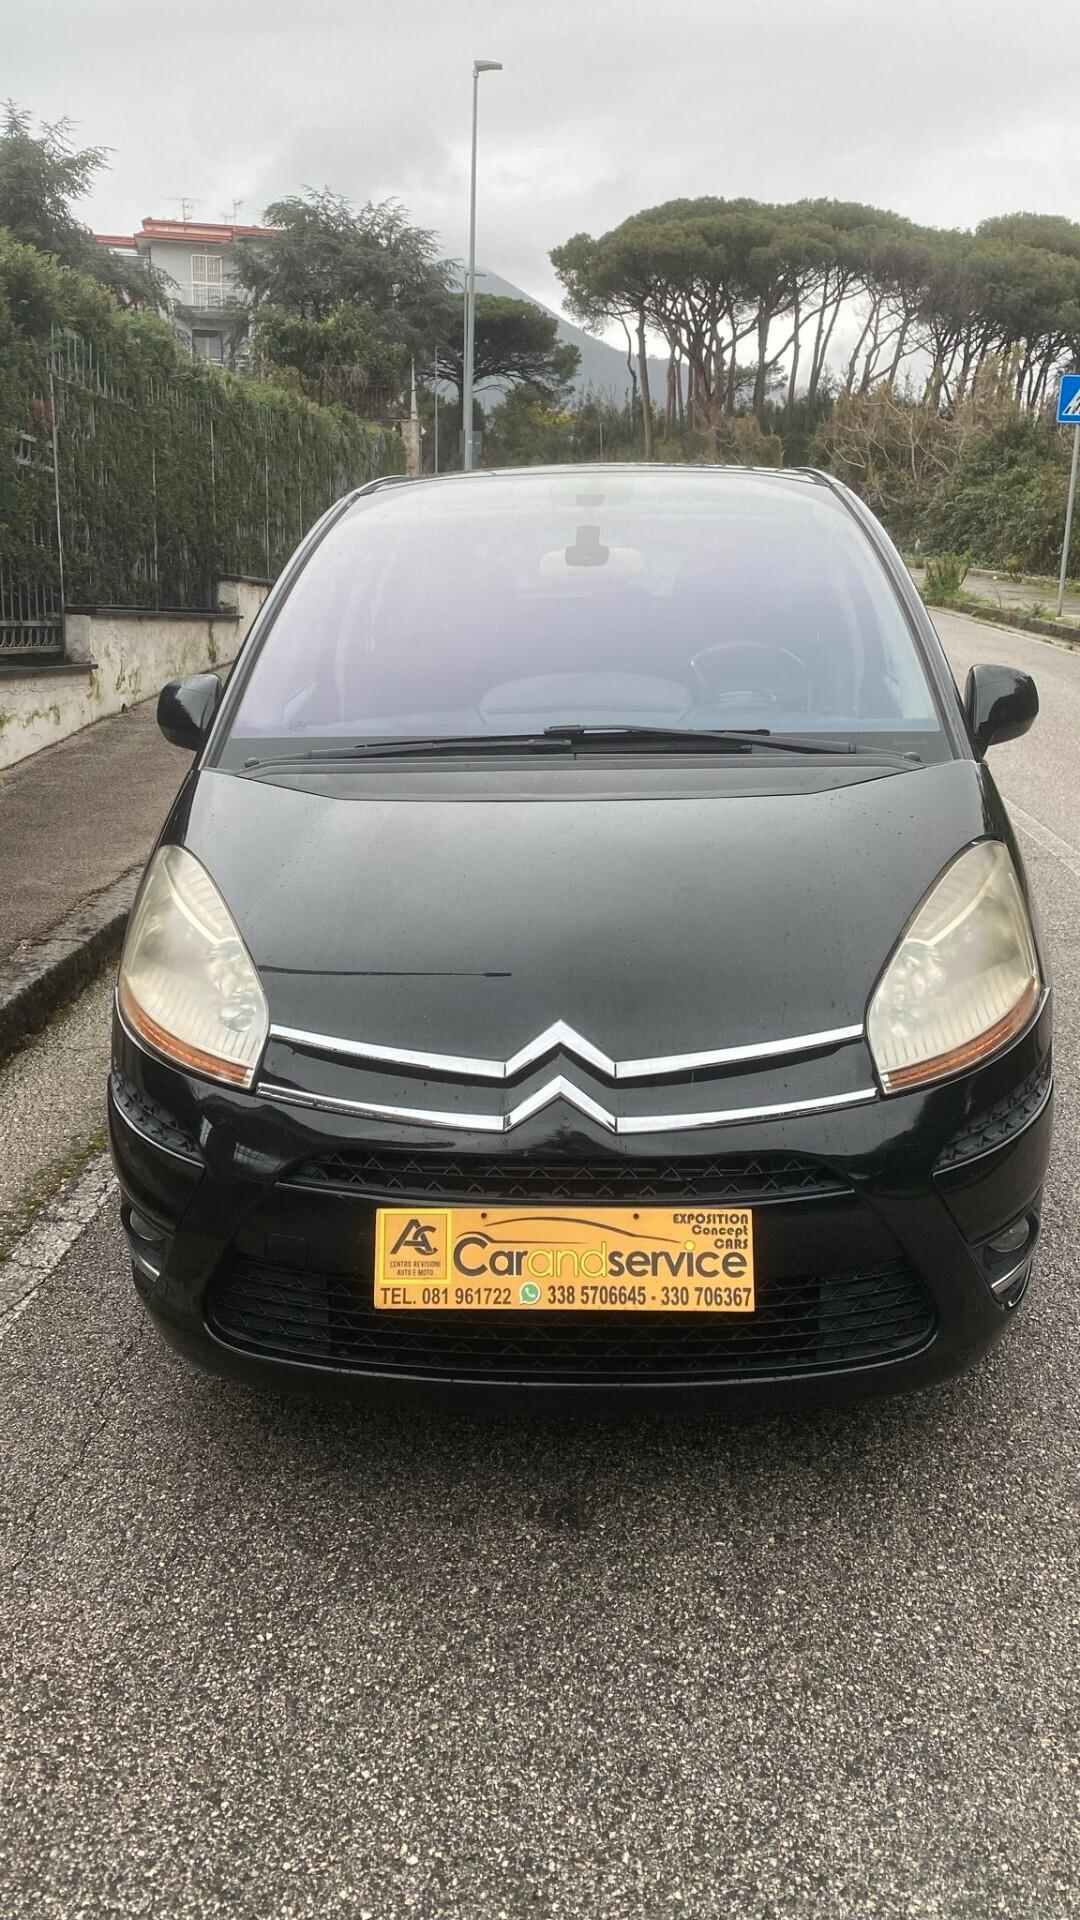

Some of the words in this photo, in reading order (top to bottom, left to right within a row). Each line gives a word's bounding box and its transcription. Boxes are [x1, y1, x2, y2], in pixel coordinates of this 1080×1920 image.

[672, 1213, 748, 1225] EXPOSITION
[691, 1225, 748, 1237] Concept
[714, 1238, 748, 1249] CARS
[453, 1236, 748, 1278] Carandservice
[390, 1260, 411, 1268] CENTRO
[413, 1260, 441, 1268] REVISIONI
[380, 1287, 416, 1305] TEL.
[422, 1287, 448, 1305] 081
[455, 1287, 512, 1305] 961722
[547, 1285, 575, 1304] 338
[580, 1285, 646, 1305] 5706645
[660, 1286, 689, 1306] 330
[694, 1287, 752, 1306] 706367
